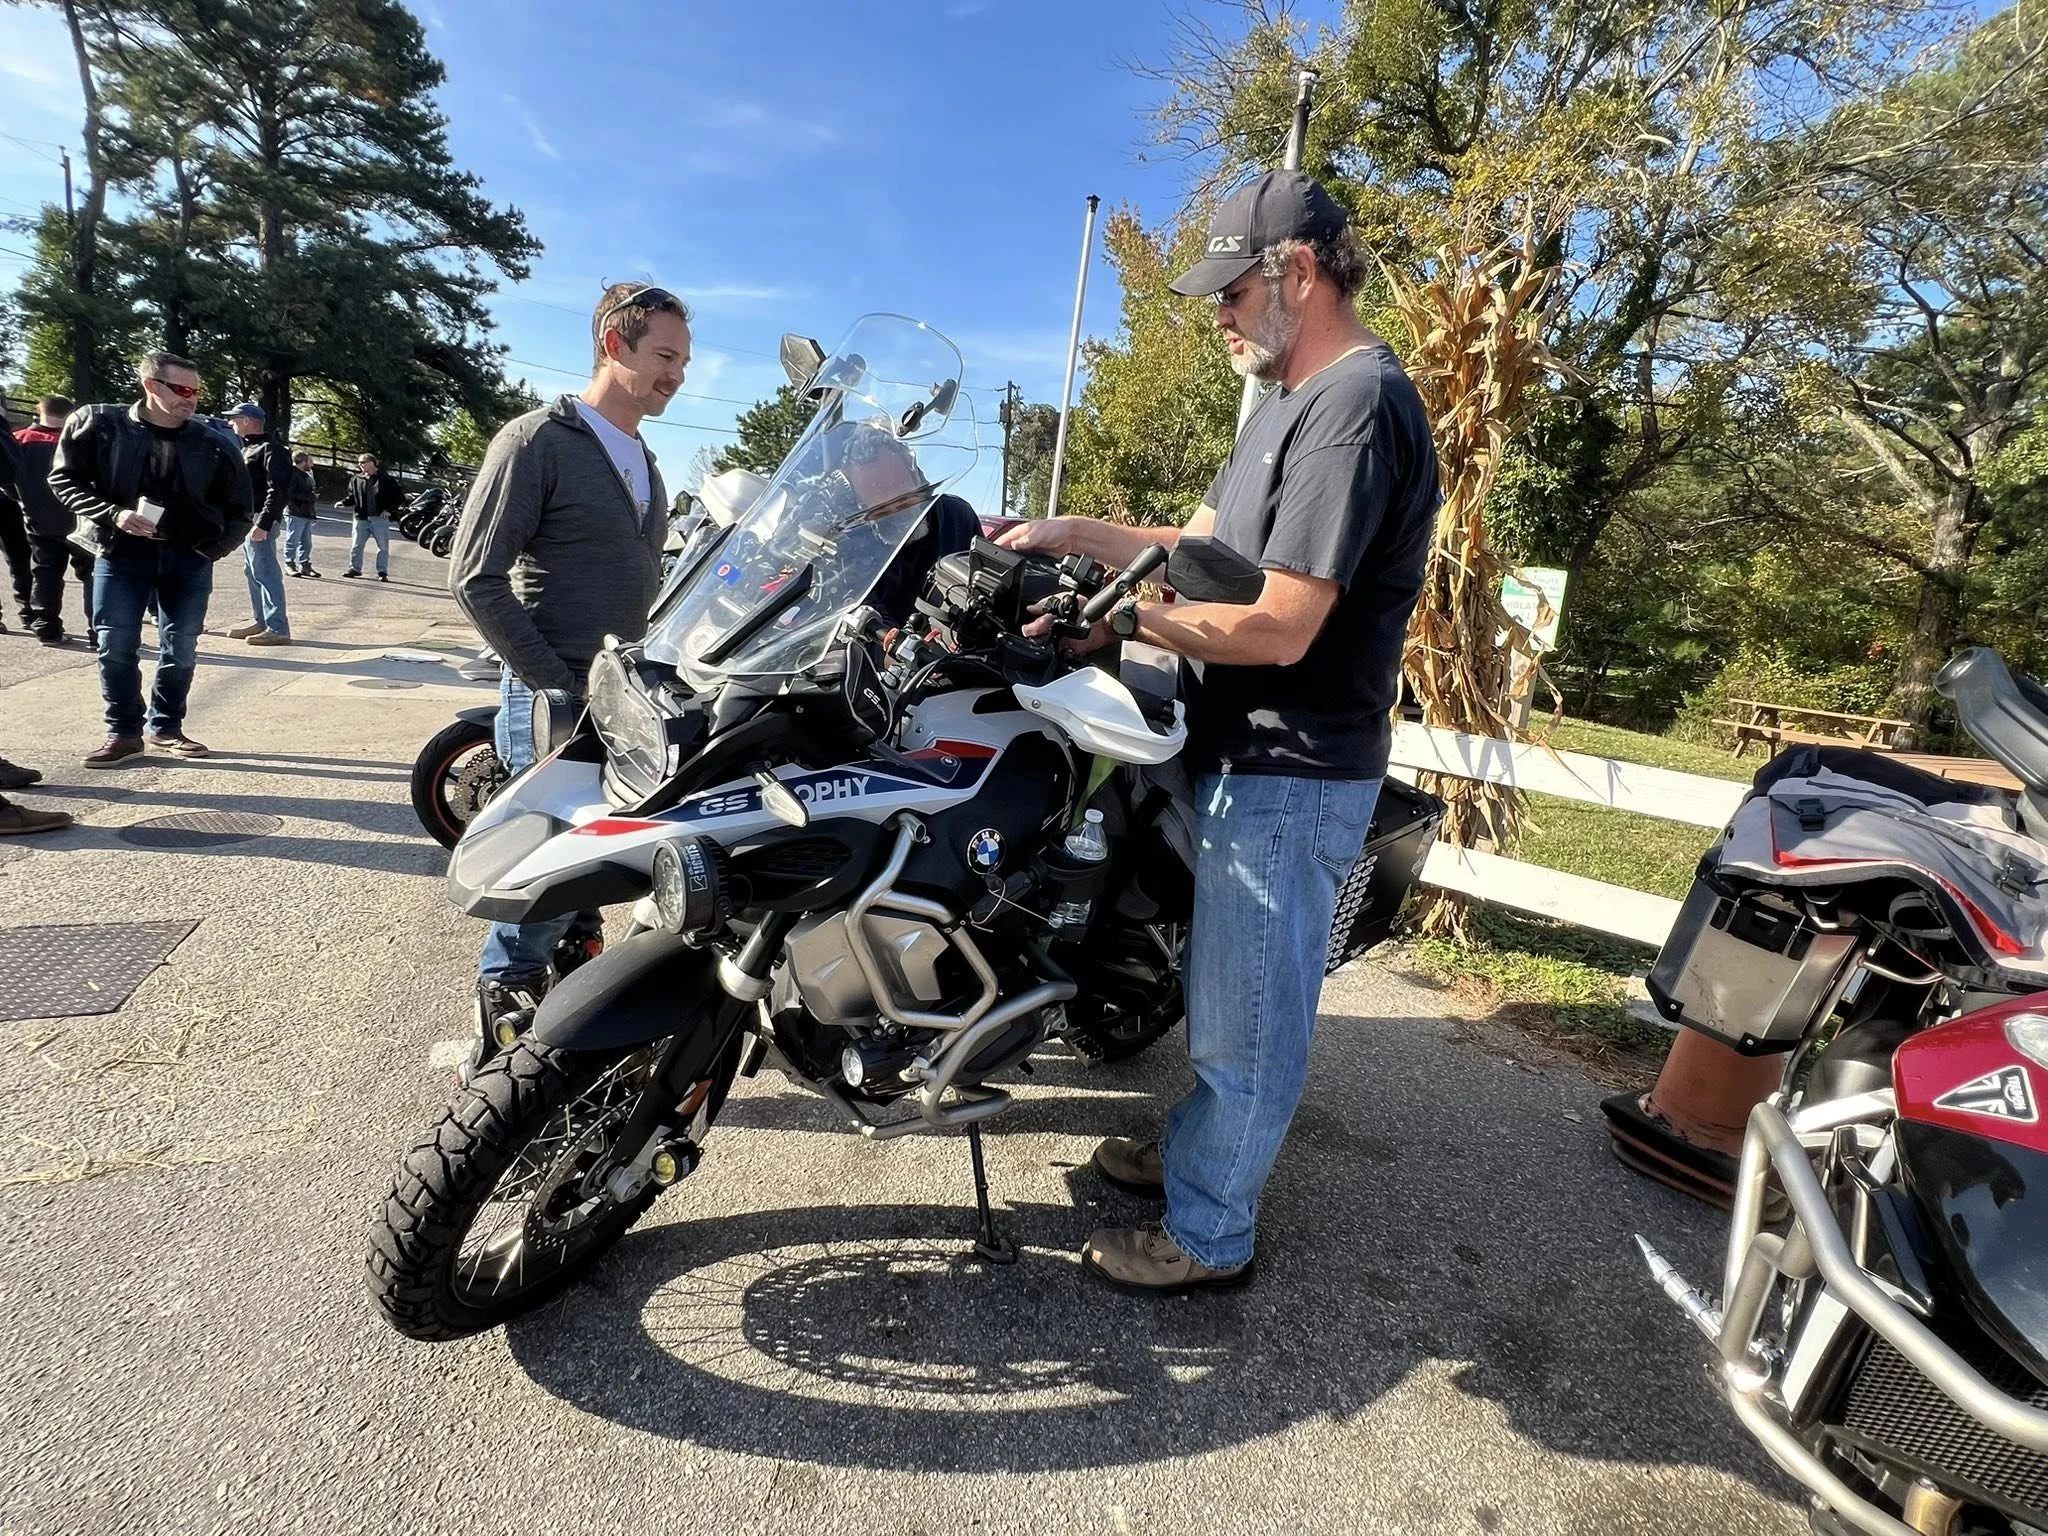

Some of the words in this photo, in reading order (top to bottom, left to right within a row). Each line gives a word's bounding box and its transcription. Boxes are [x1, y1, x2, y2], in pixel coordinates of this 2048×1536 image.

[1208, 235, 1245, 253] GS
[863, 687, 881, 705] GS
[699, 793, 748, 816] GS
[971, 831, 1001, 849] BMW
[2004, 1075, 2027, 1110] TRIUMPH
